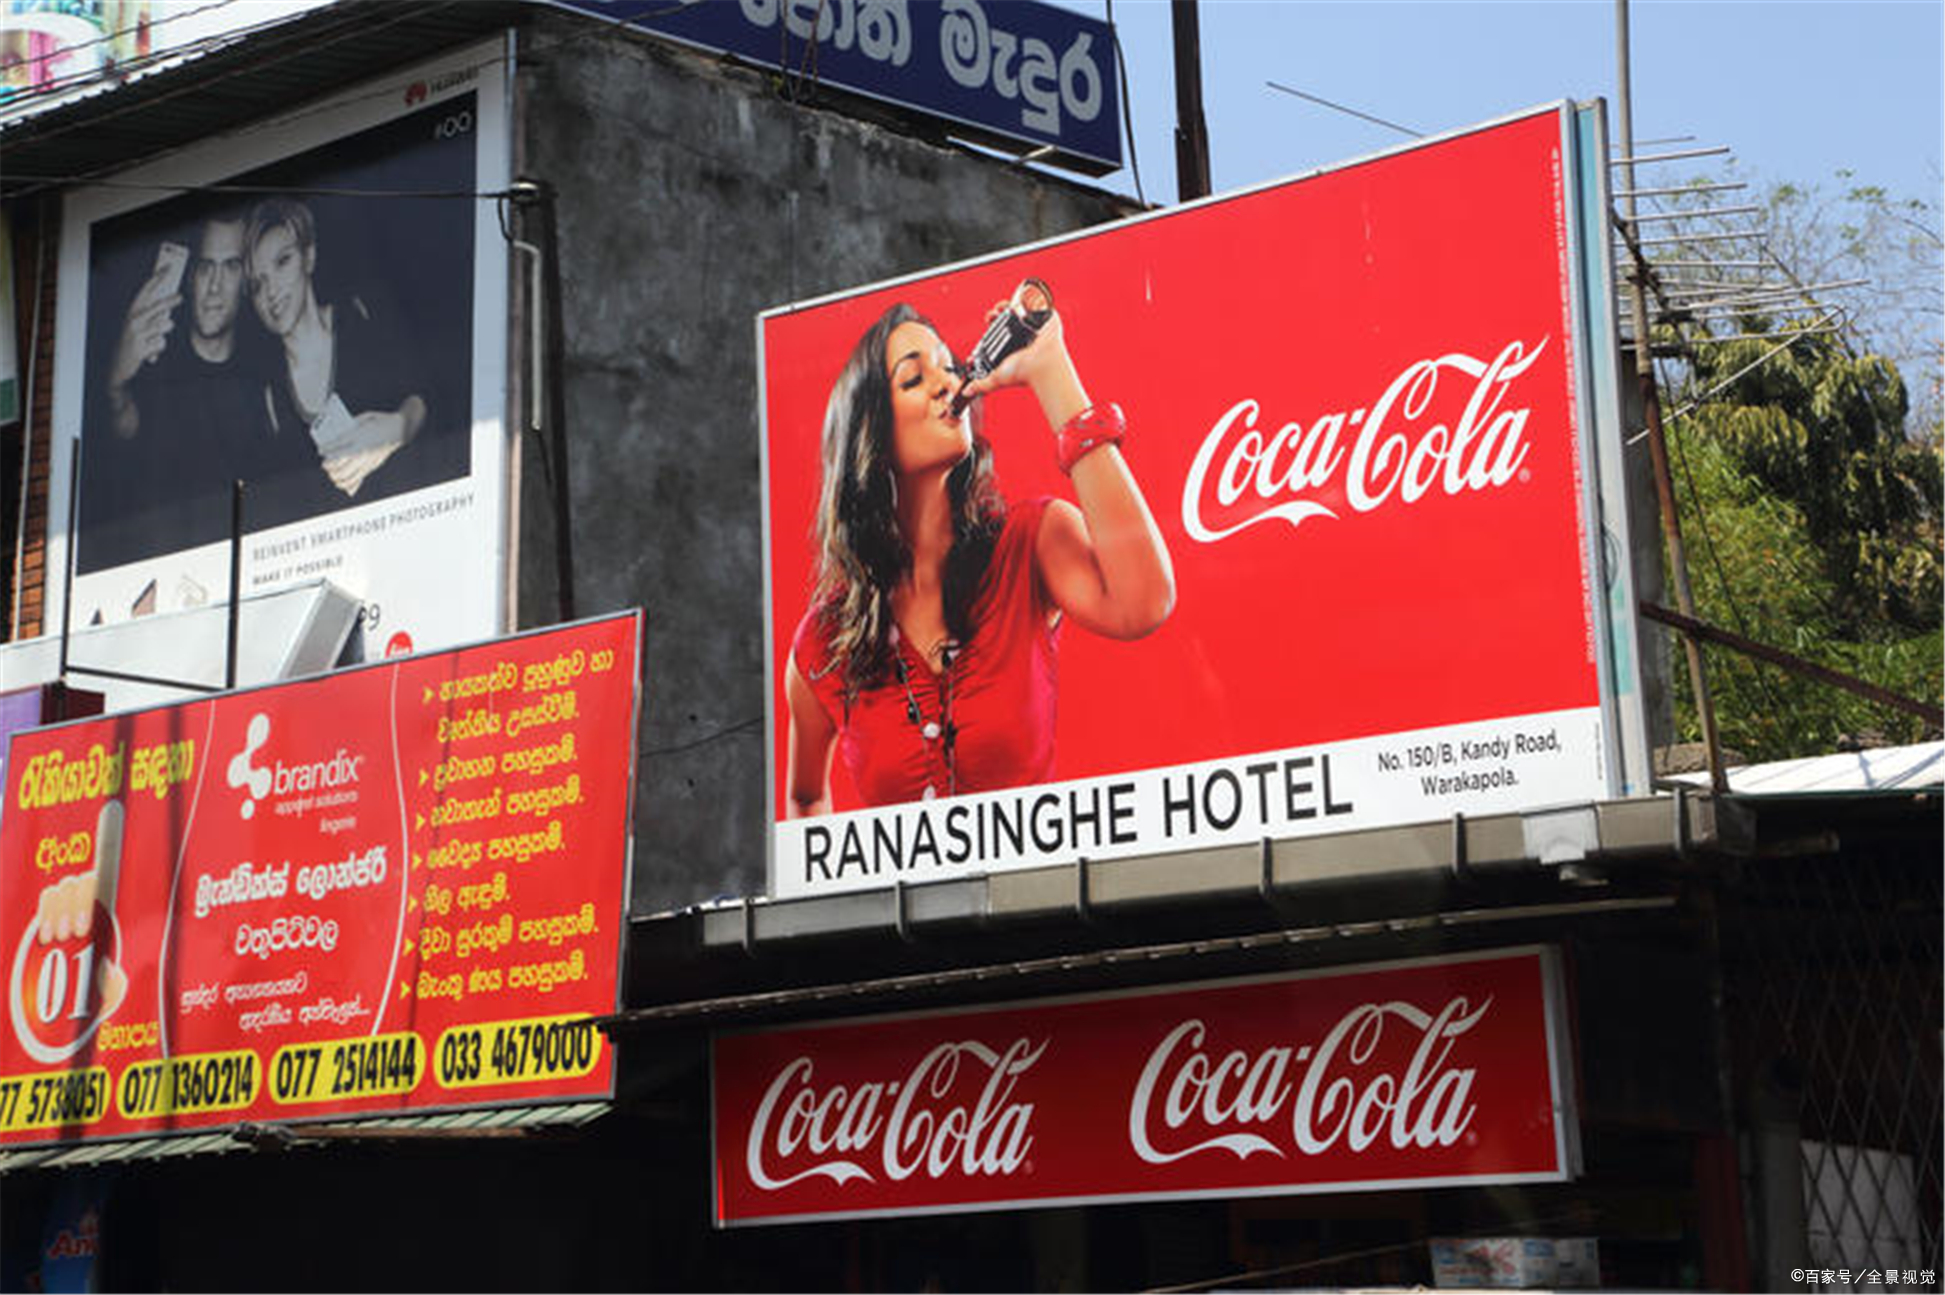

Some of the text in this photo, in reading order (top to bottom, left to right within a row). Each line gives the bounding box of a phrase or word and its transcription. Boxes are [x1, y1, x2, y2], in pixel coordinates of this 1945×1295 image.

[940, 0, 1101, 135] මැදුර
[1182, 333, 1550, 543] Coca-Cola
[311, 516, 386, 548] SMARTPHONE
[389, 493, 475, 528] PHOTOGRAPHY
[296, 555, 344, 576] POSSIBLE
[130, 739, 195, 799] සඳහා
[274, 748, 360, 795] brandix
[1378, 729, 1561, 772] No. 150/B, Kandy Road,
[1421, 767, 1519, 796] Warakapola.
[803, 753, 1353, 883] RANASINGHE HOTEL
[36, 943, 94, 1024] 01
[276, 1036, 417, 1098] 077 2514144
[442, 1020, 592, 1082] 033 4679000
[1130, 995, 1494, 1164] Coca-Cola
[124, 1050, 253, 1115] 077 1360214
[747, 1038, 1052, 1190] Coca-Cola
